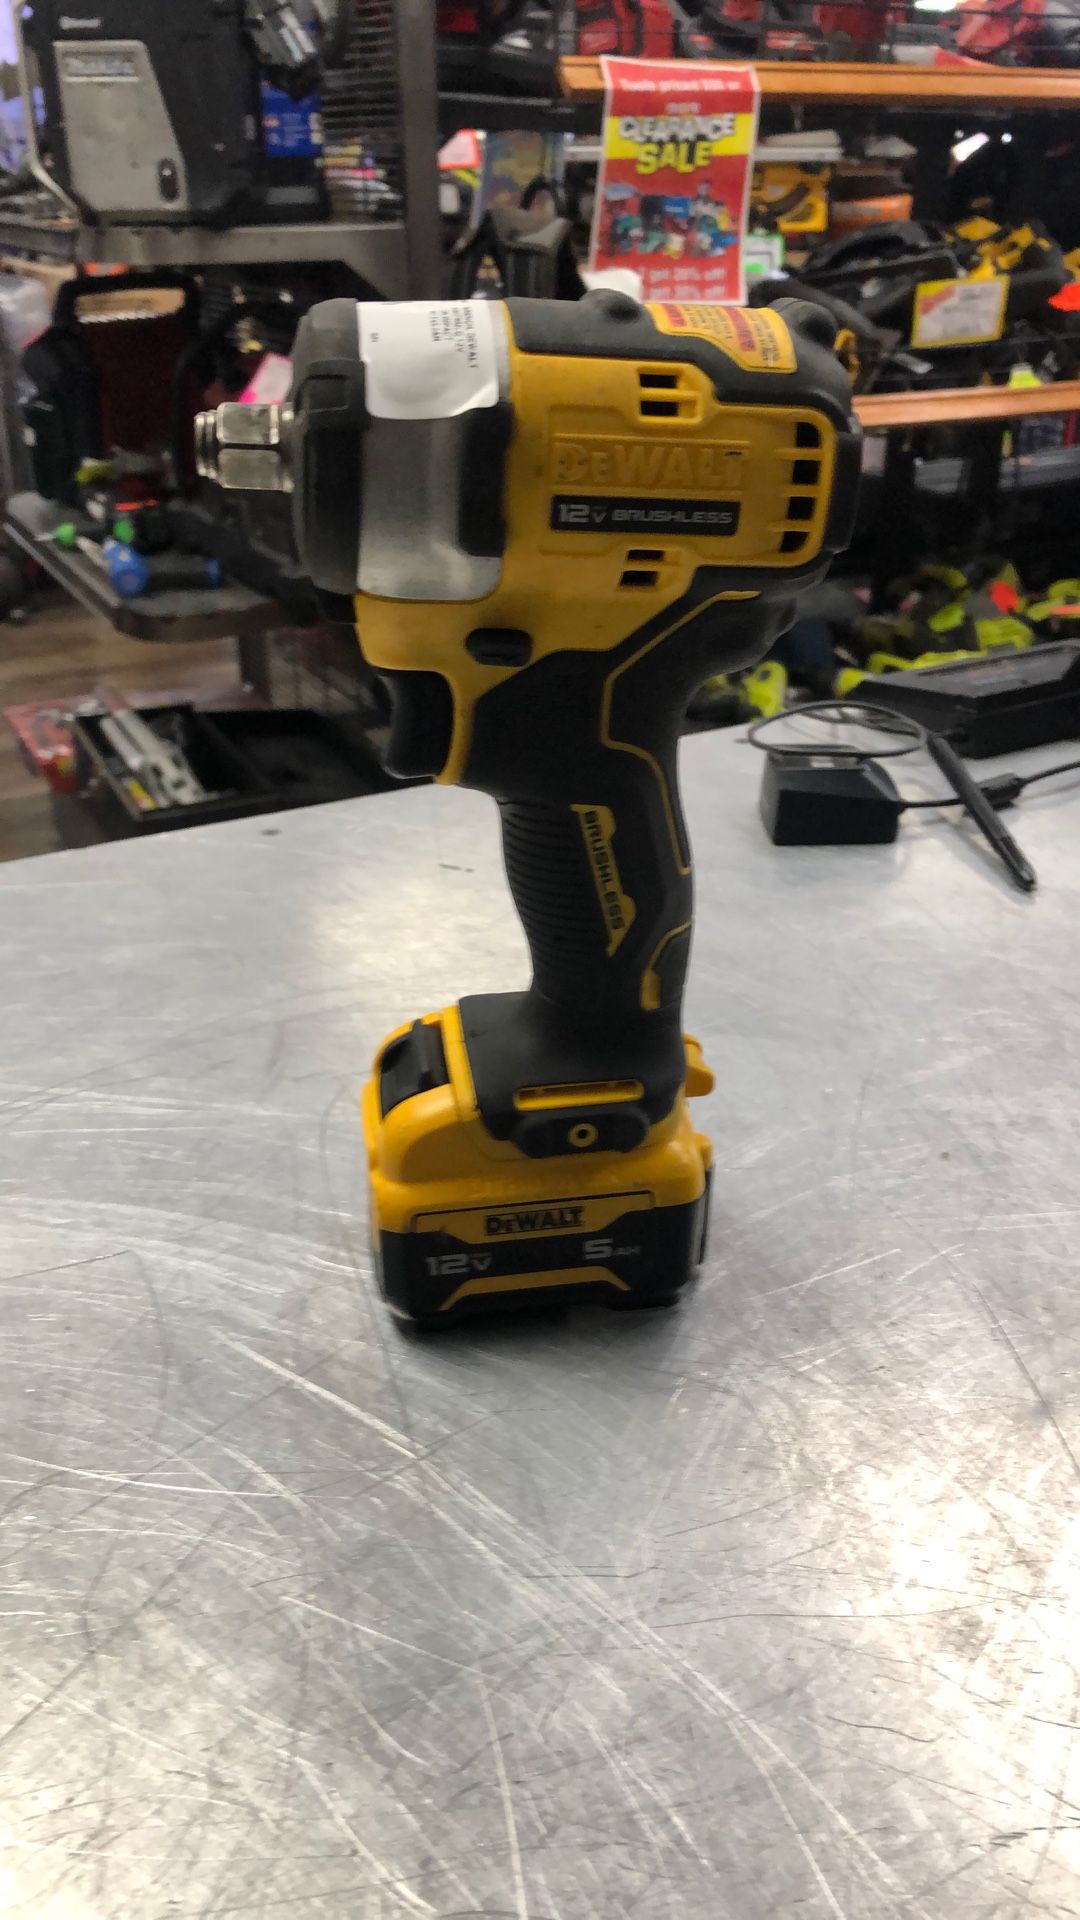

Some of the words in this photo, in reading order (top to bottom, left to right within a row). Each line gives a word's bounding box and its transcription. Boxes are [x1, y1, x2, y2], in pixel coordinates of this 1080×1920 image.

[619, 113, 735, 143] CLEARANCE
[636, 141, 712, 175] SALE
[612, 509, 733, 524] BRUSHLESS
[584, 810, 626, 930] BRUSHLESS
